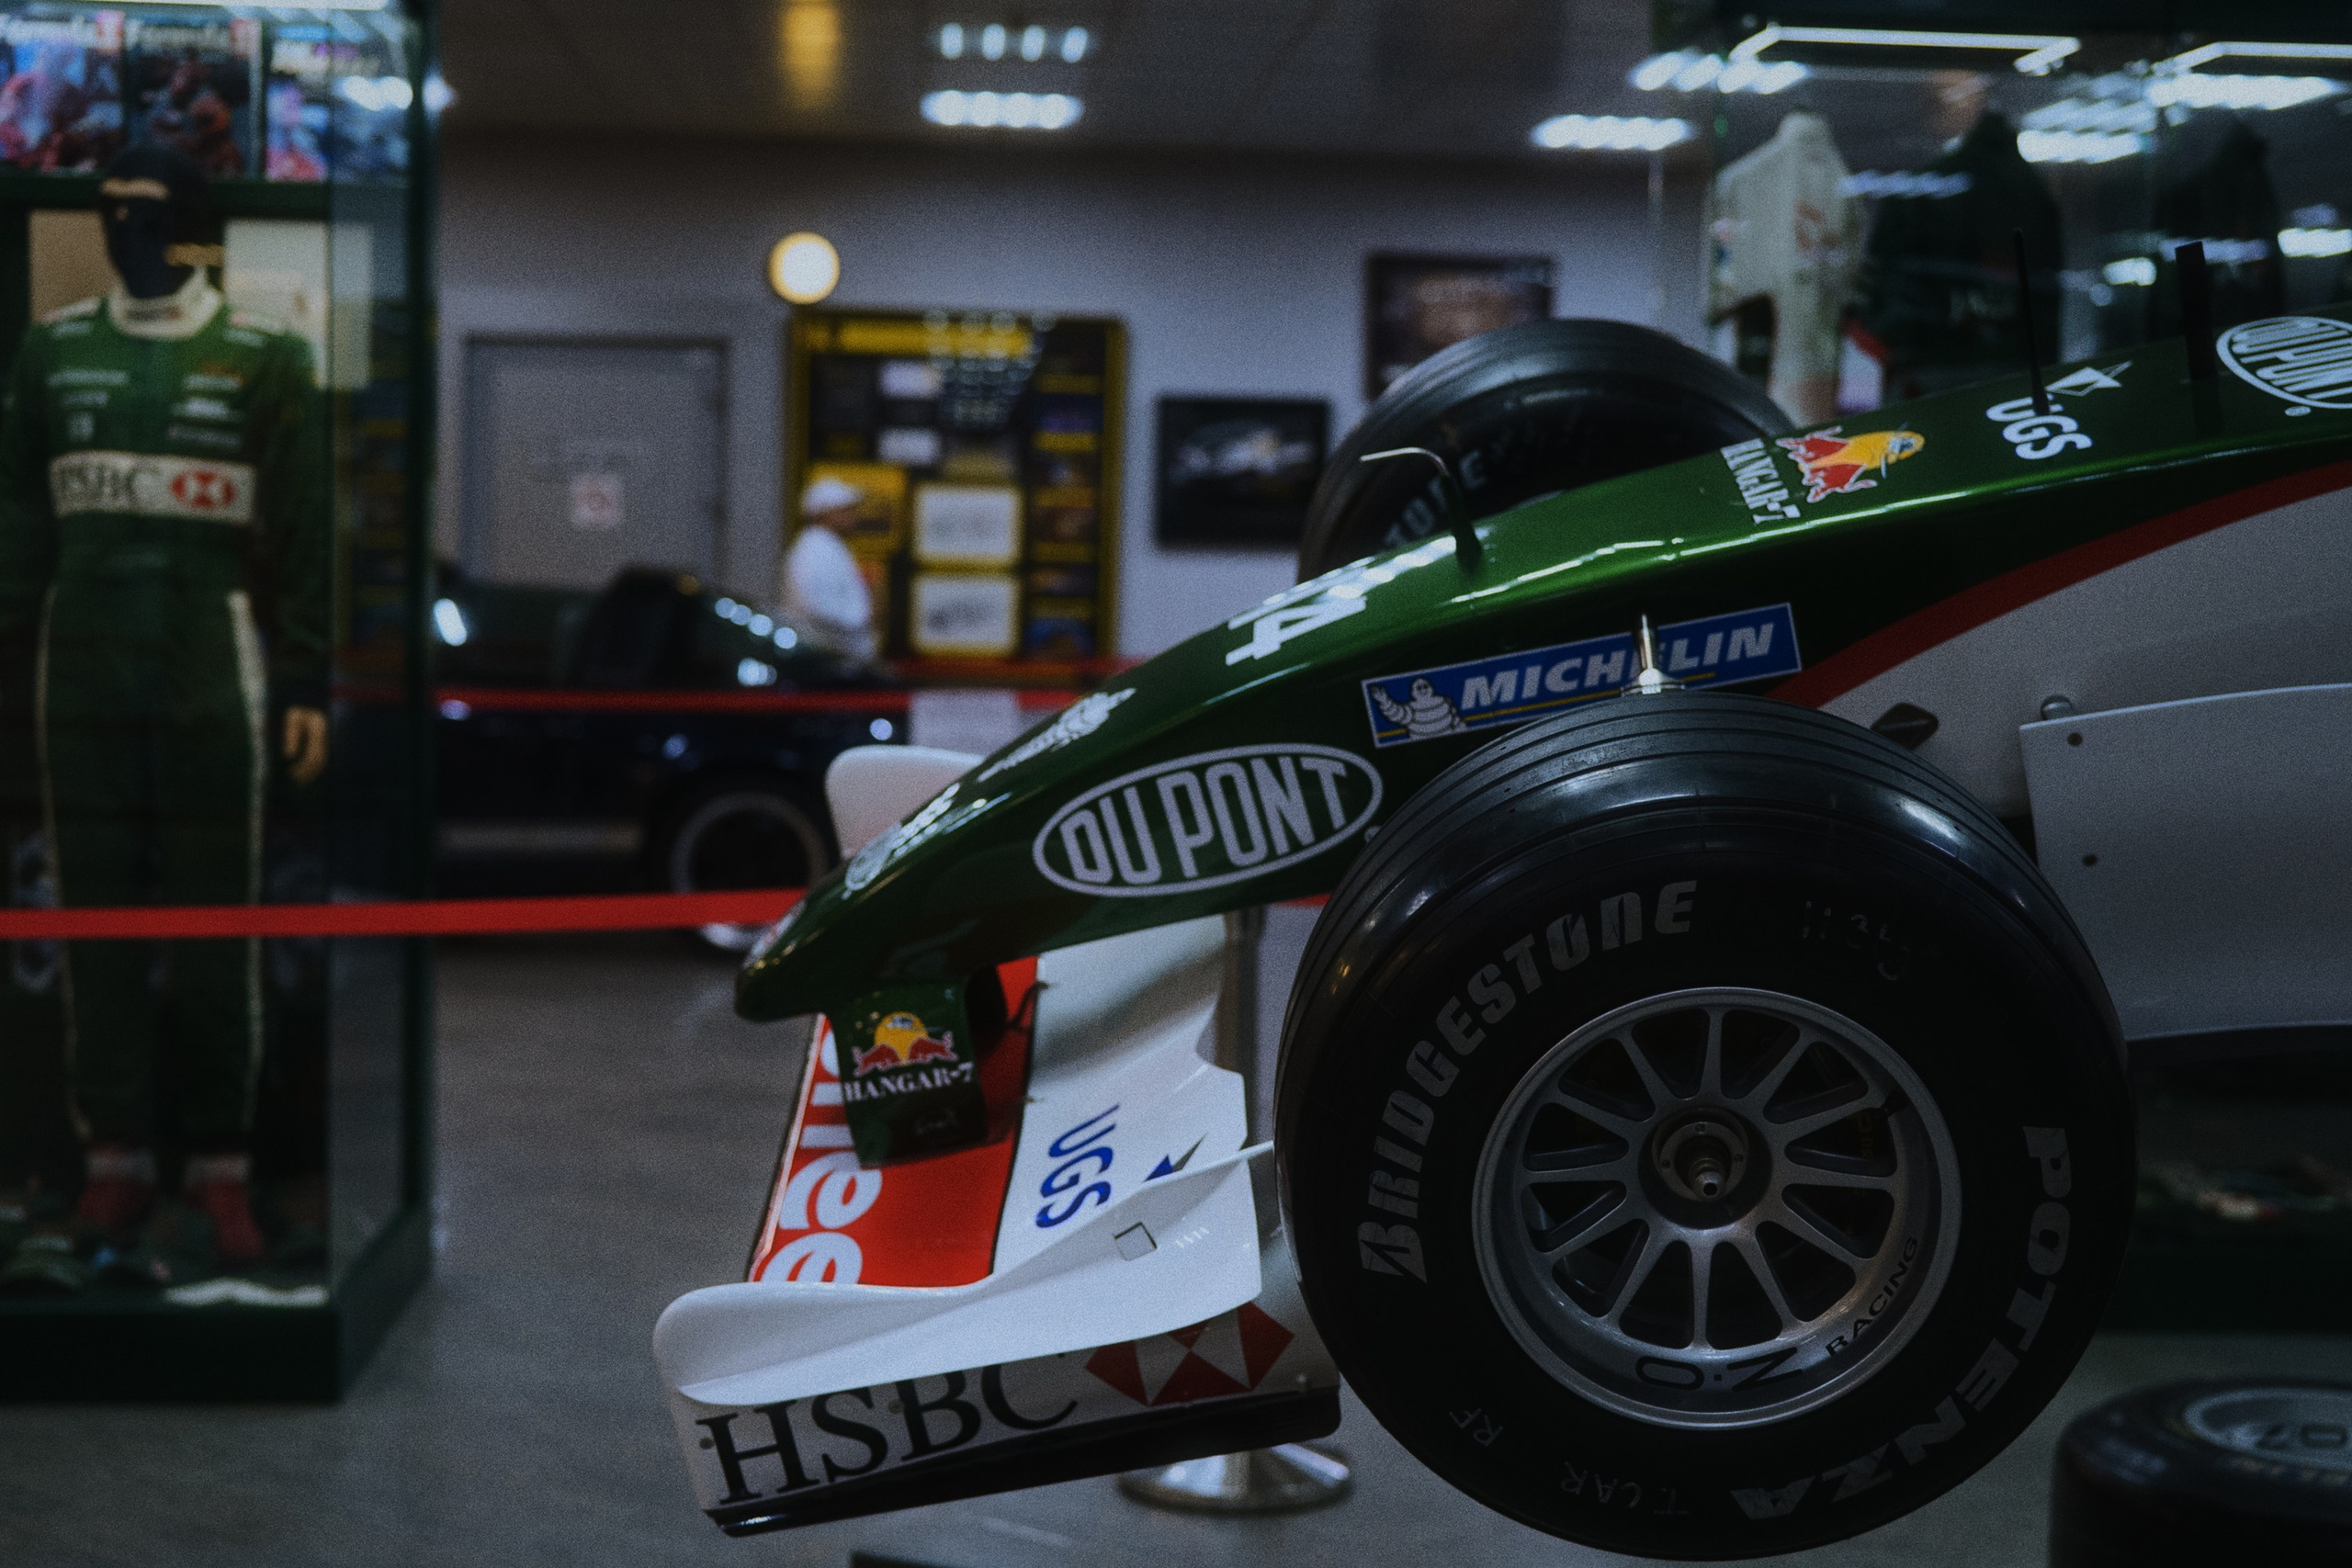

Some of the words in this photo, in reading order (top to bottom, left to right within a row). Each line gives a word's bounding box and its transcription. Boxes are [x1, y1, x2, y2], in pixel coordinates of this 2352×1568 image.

[1985, 394, 2093, 460] UGS
[1461, 622, 1774, 711] MICHLIN
[1357, 880, 1698, 1283] BRIDGESTONE
[1035, 1104, 1120, 1228] UGS
[1730, 1126, 2072, 1520] POTENZA
[1826, 1236, 1918, 1358] RACING
[695, 1354, 1079, 1506] HSBC
